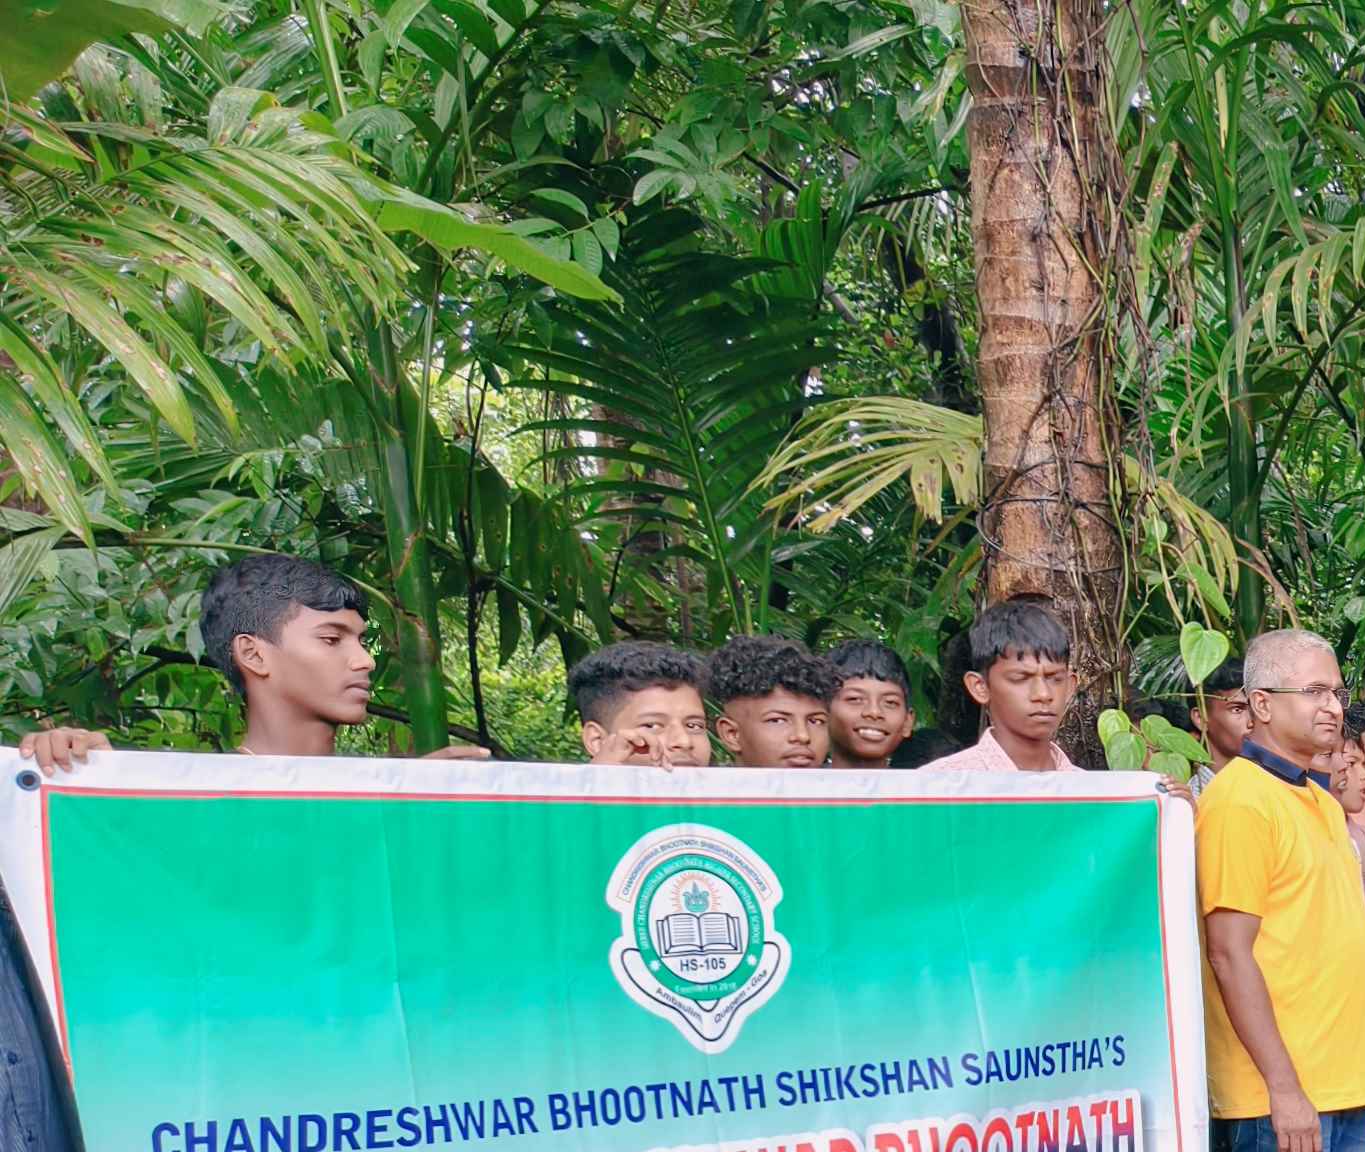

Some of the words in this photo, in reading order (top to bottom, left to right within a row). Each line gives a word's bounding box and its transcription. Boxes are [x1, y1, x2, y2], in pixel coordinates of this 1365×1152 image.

[680, 958, 726, 972] HS-105
[550, 1075, 765, 1131] BHOOTNATH
[776, 1056, 953, 1107] SHIKSHAN
[963, 1035, 1126, 1086] SAUNSTHA'S
